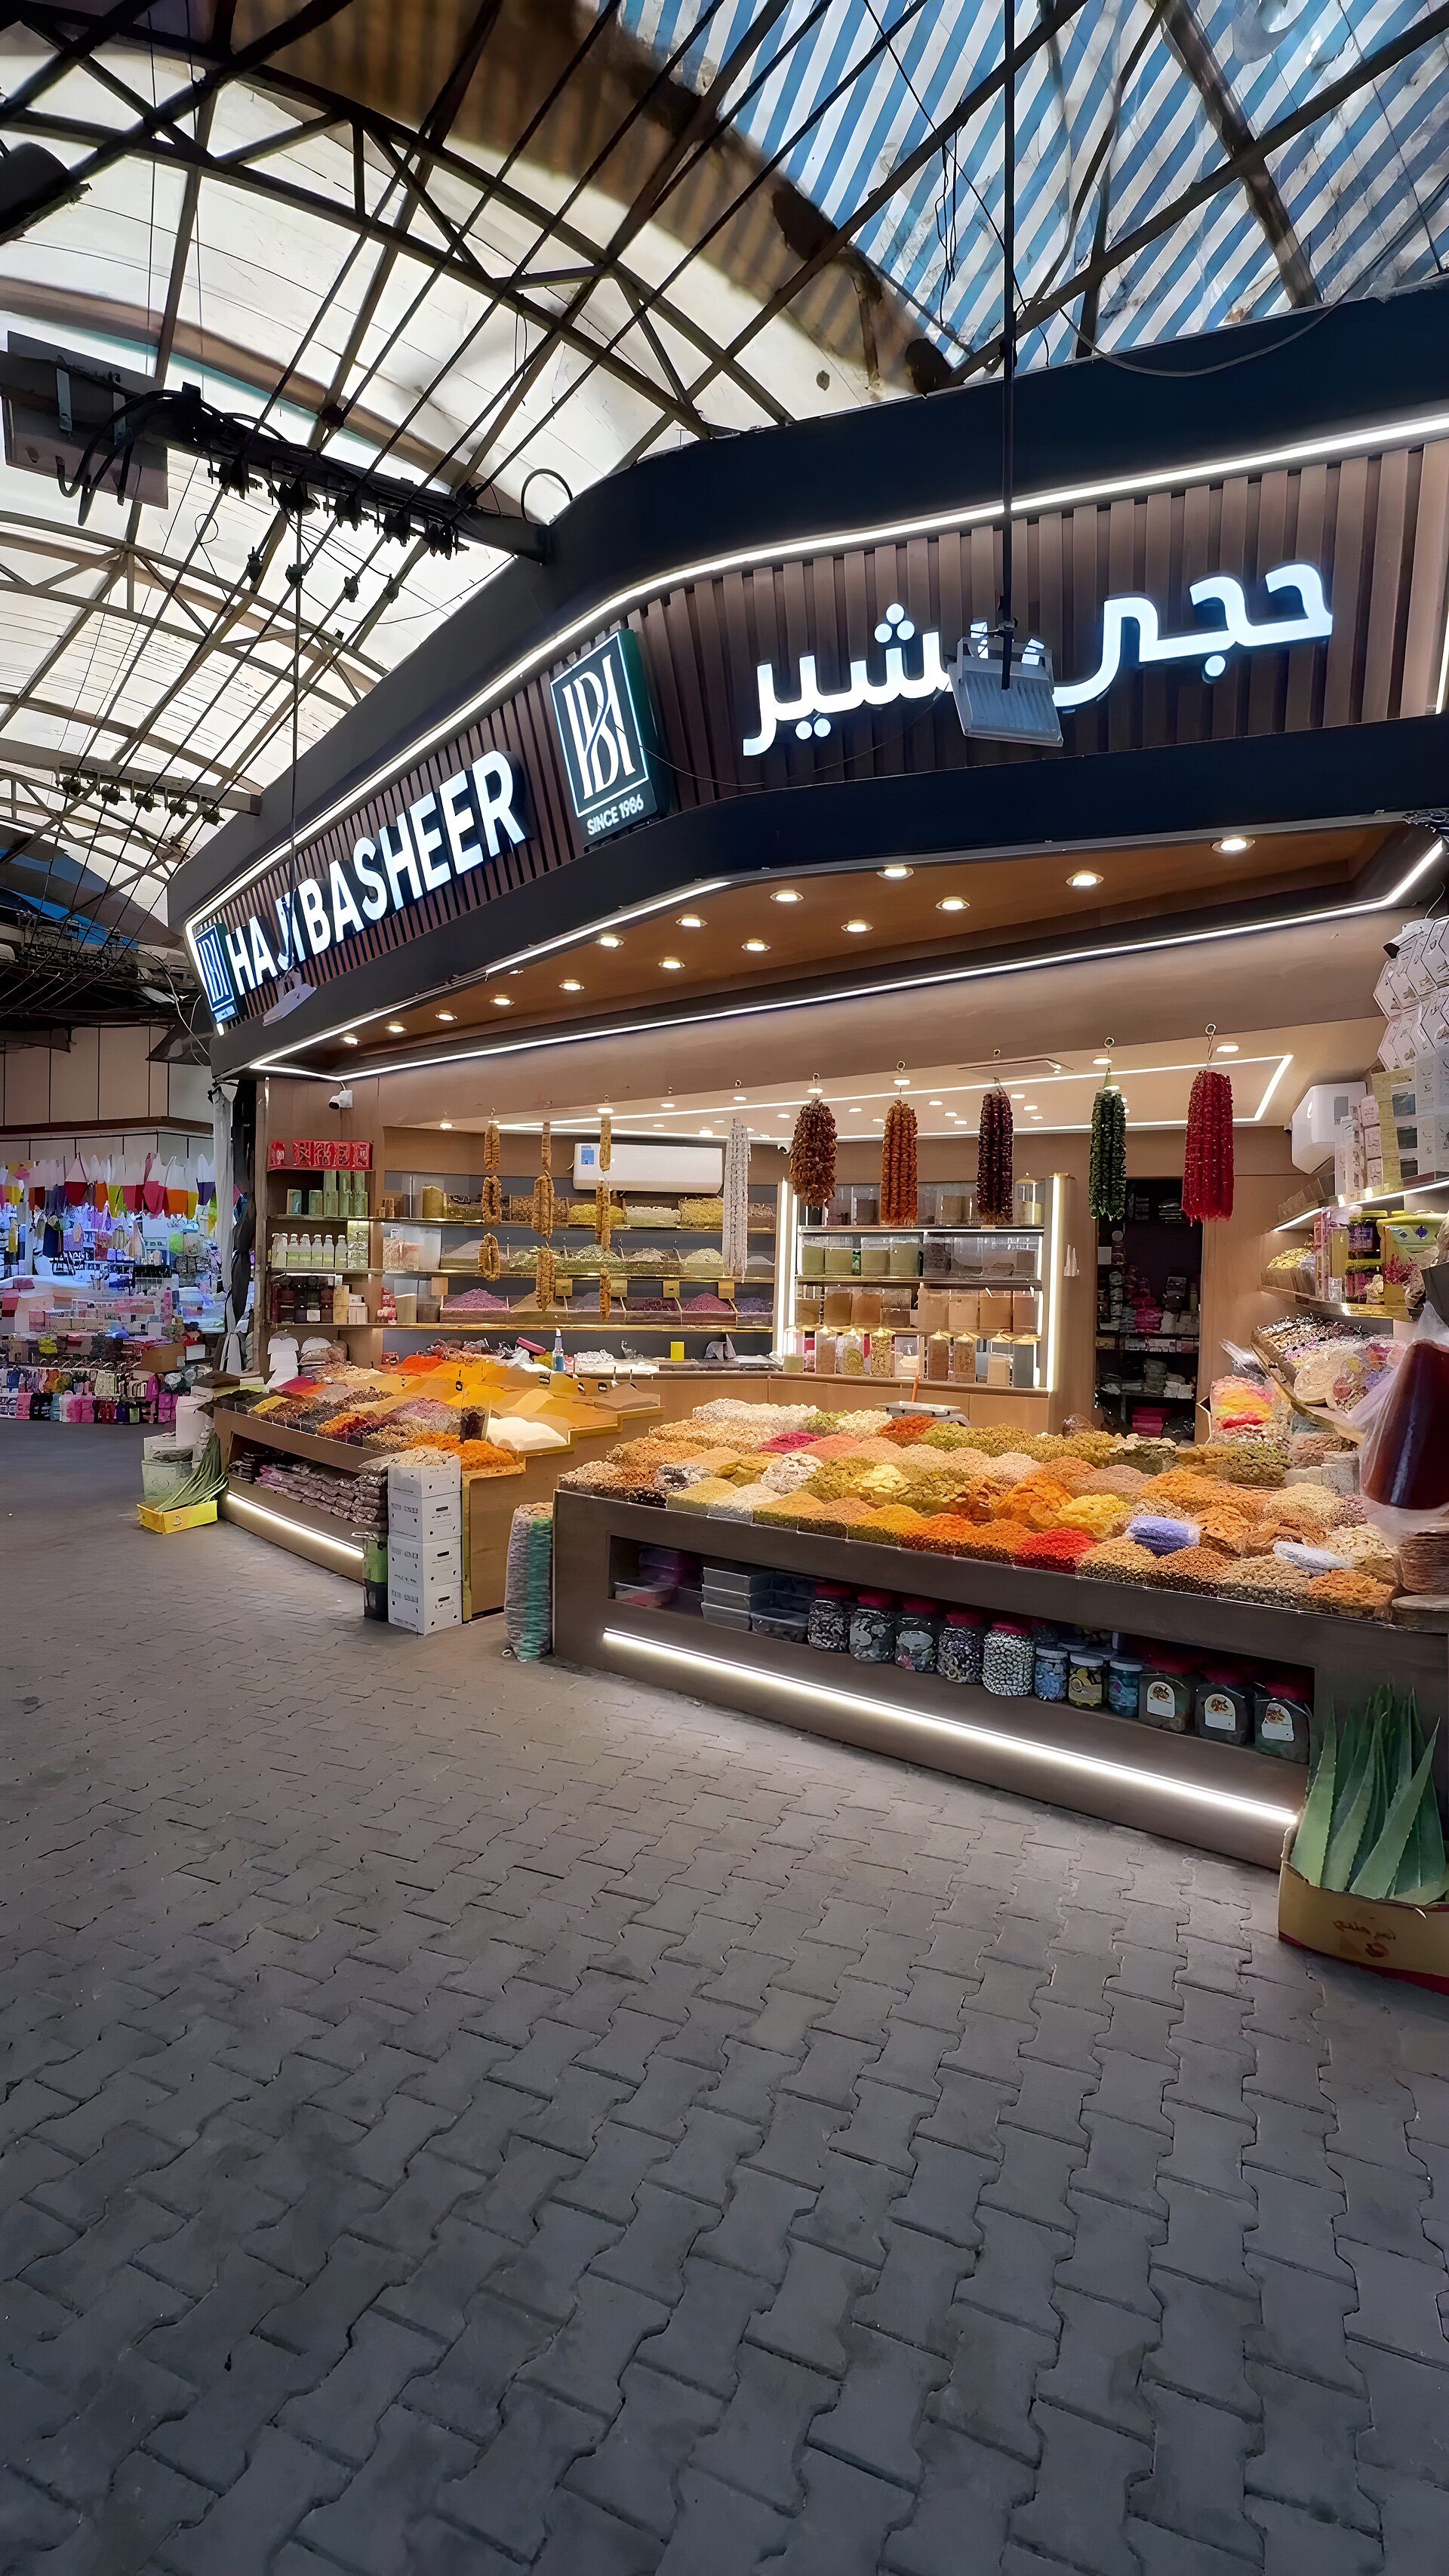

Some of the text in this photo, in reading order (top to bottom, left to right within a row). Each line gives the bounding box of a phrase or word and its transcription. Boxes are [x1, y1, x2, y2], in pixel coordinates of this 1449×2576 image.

[298, 750, 526, 955] BASHEER
[586, 793, 644, 836] SINCE 1986
